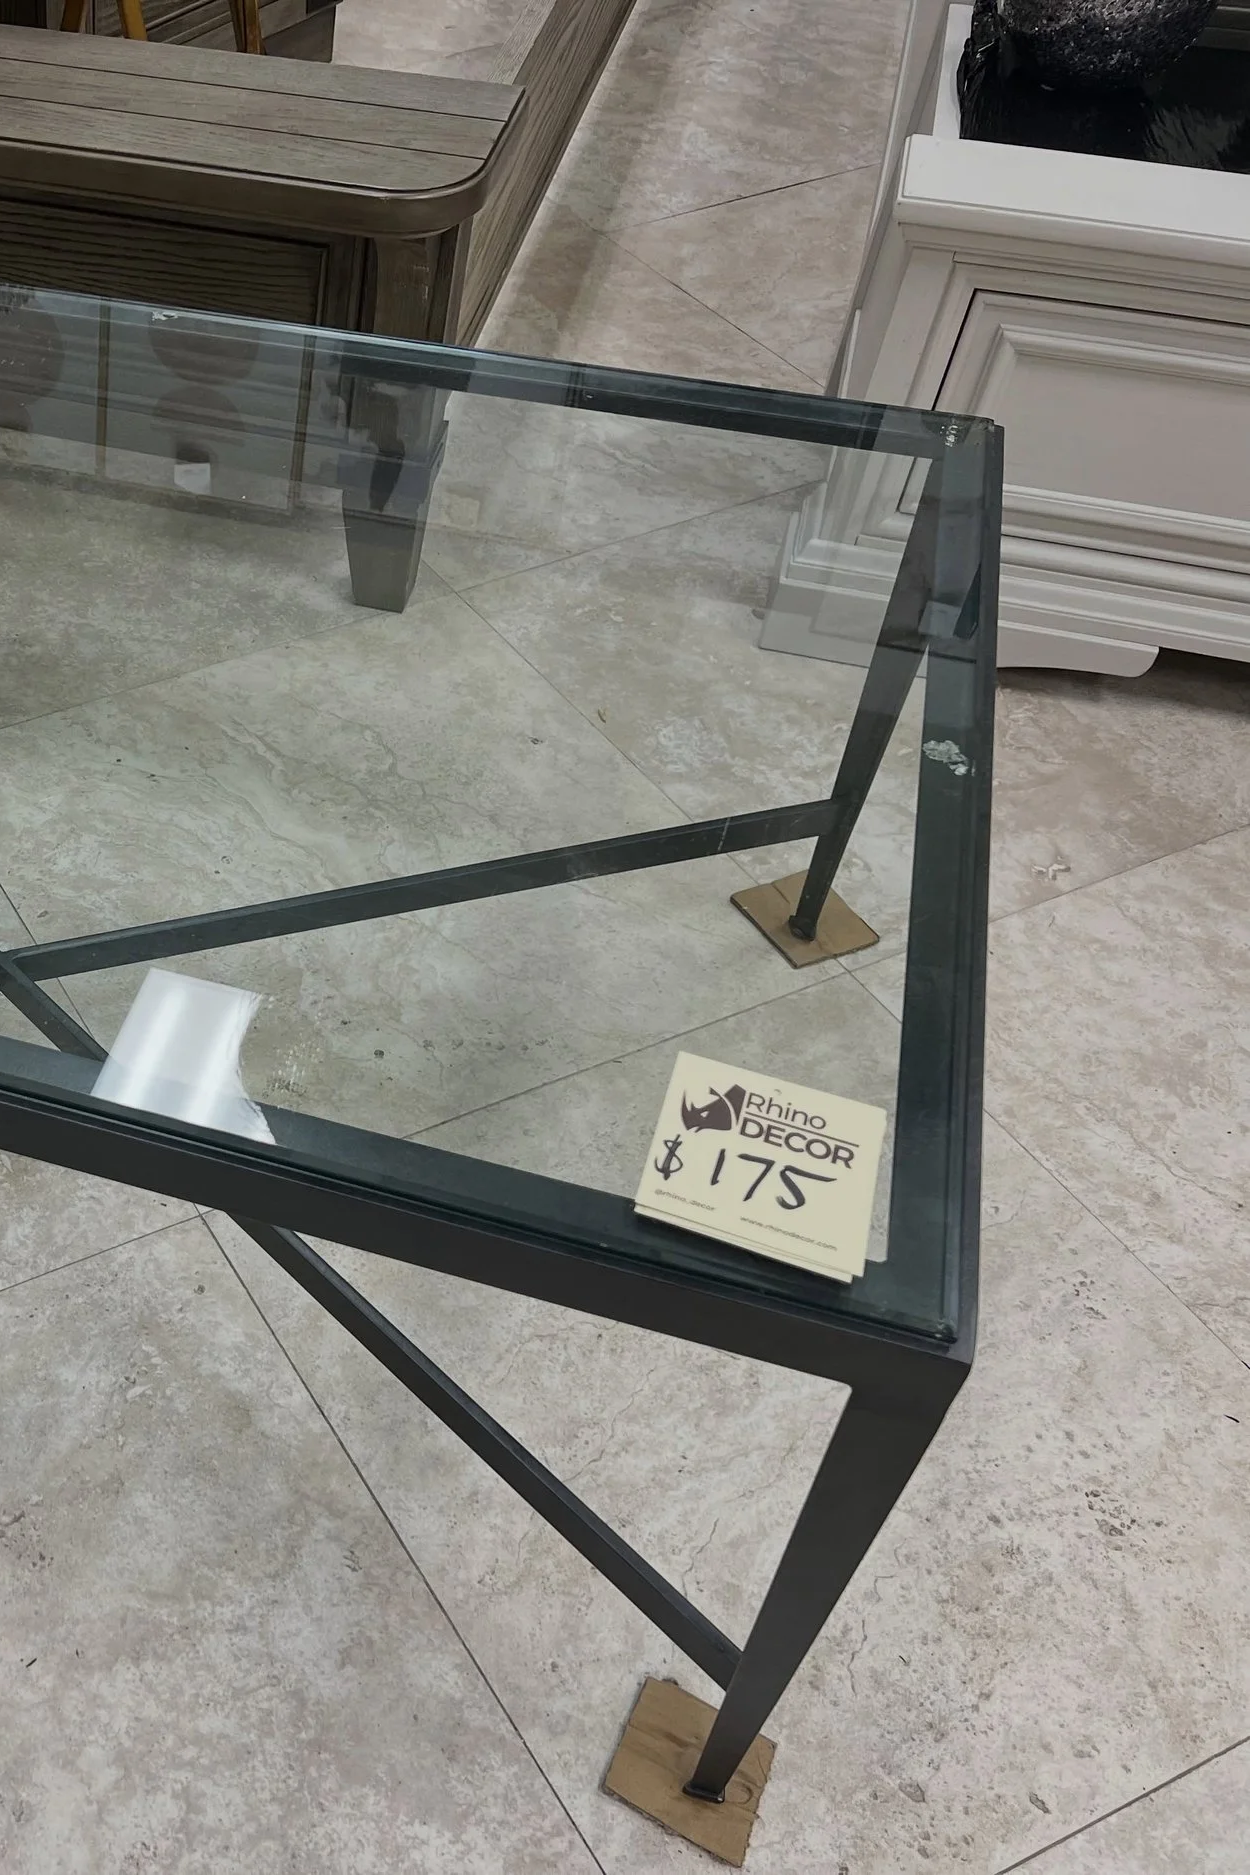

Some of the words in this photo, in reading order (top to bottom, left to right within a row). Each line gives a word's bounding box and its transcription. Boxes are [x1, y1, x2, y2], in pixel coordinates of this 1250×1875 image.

[747, 1092, 826, 1129] Rhino
[740, 1117, 854, 1168] DECOR
[741, 1216, 837, 1251] www.rhinodecor.com
